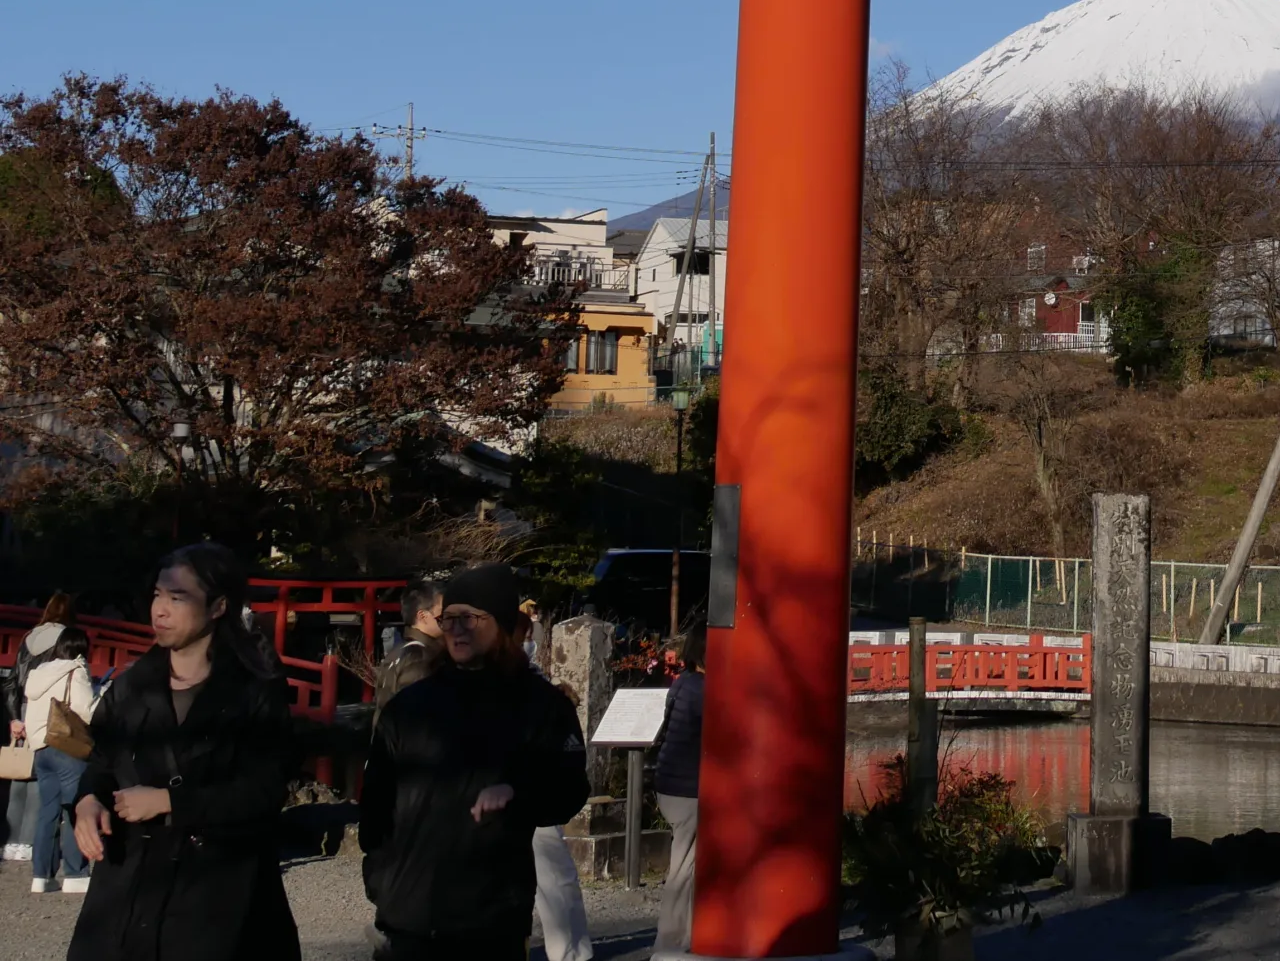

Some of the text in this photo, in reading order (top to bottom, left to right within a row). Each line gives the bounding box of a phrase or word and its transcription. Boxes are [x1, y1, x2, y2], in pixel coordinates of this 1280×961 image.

[1109, 502, 1137, 784] 特別天然記念物湧玉池
